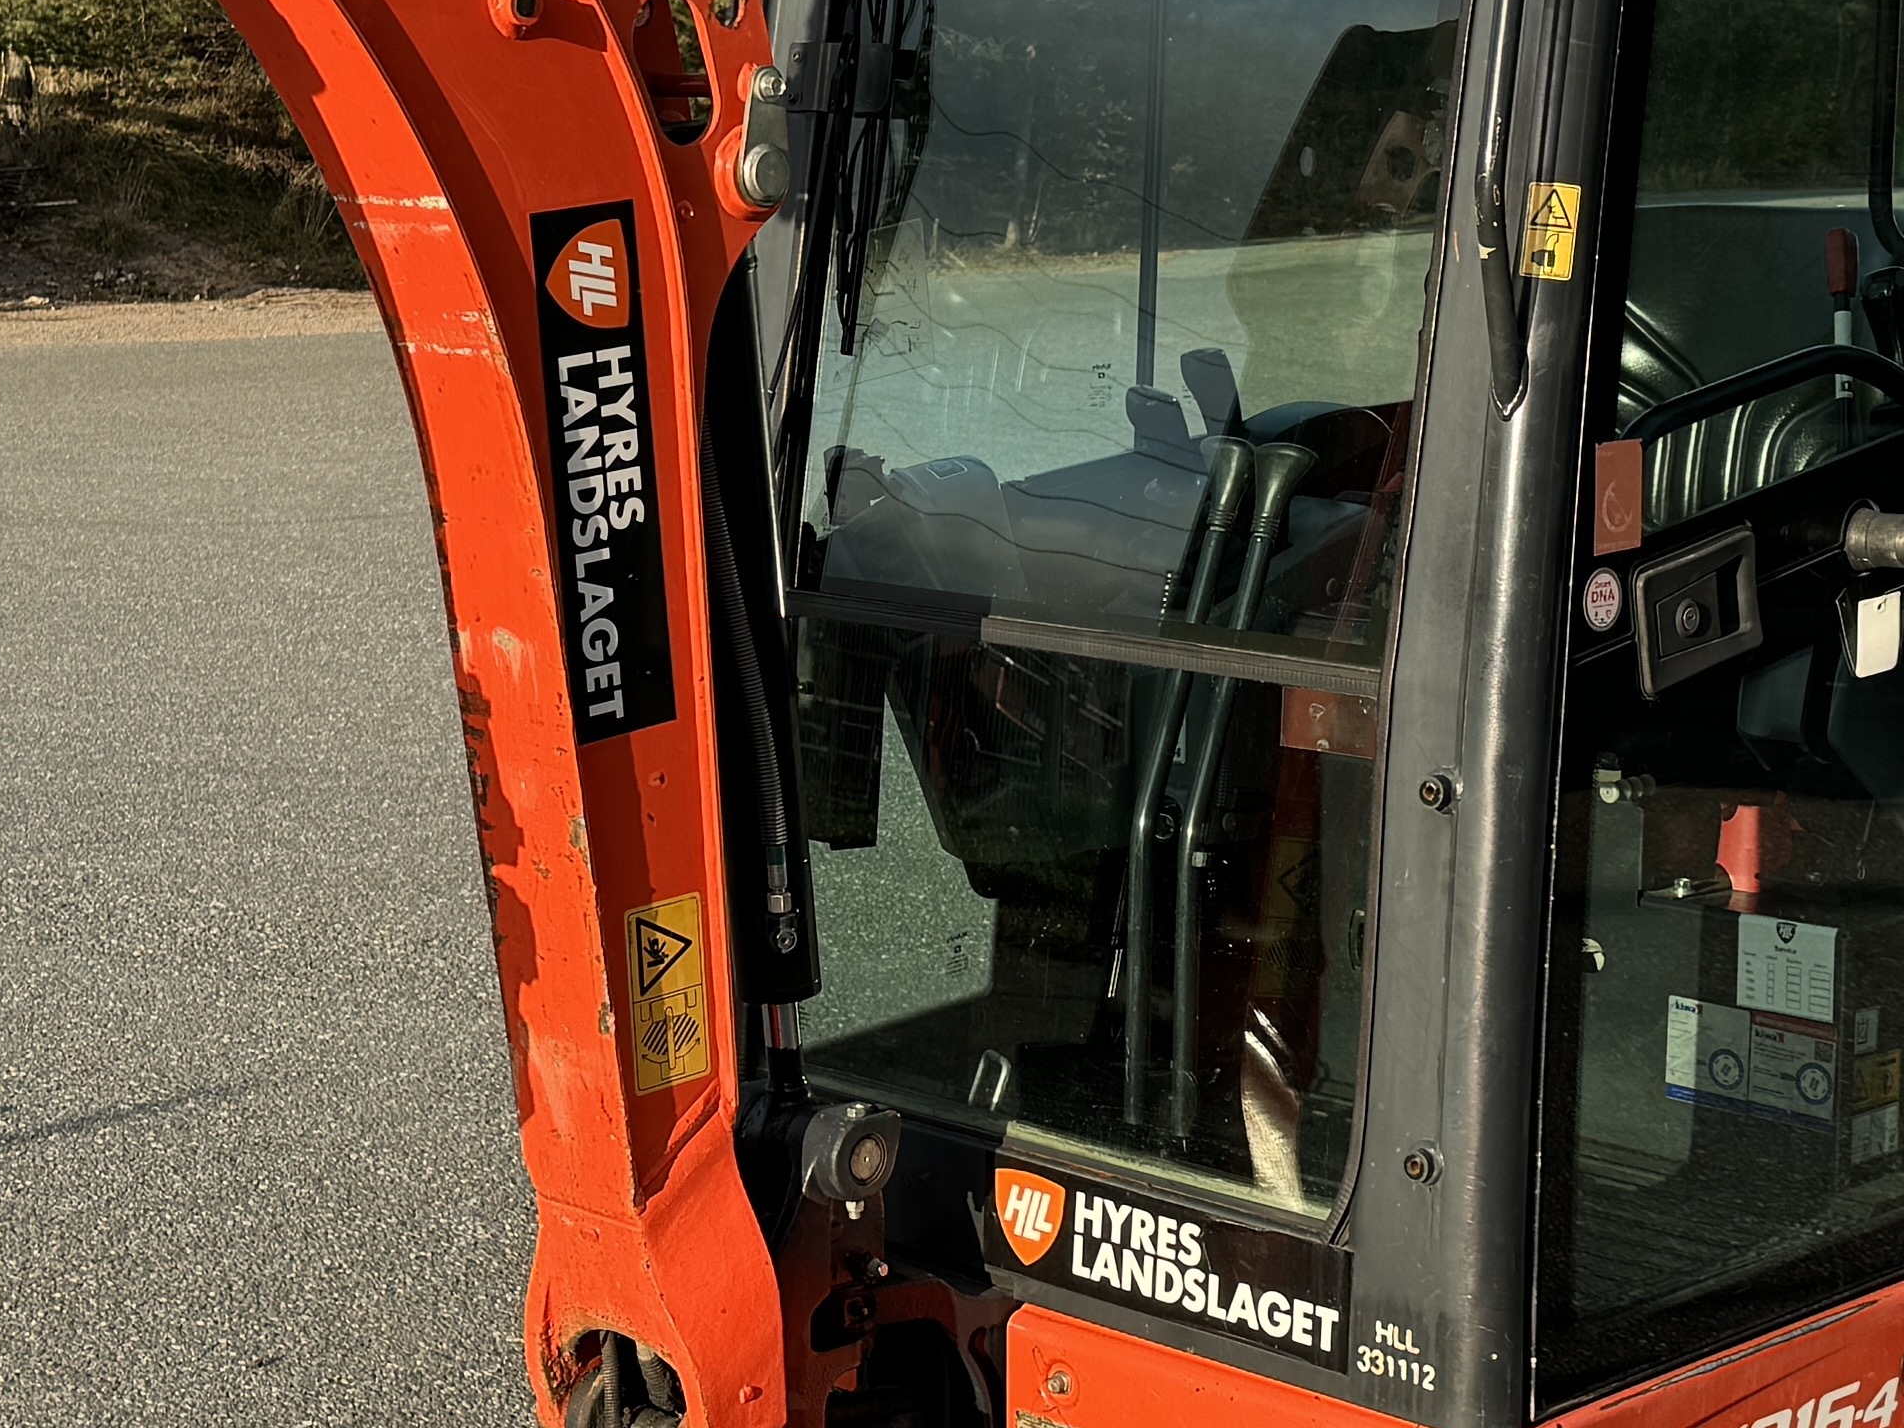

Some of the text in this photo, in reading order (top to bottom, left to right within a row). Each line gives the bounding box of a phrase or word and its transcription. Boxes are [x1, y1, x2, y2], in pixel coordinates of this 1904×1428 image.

[596, 345, 645, 531] HYRES
[557, 351, 626, 720] LANDSLAGET
[1591, 588, 1615, 604] DNA
[1004, 1184, 1053, 1241] HLL
[1074, 1191, 1203, 1267] HYRES
[1072, 1234, 1340, 1352] LANDSLAGET
[1357, 1345, 1436, 1391] 331112
[1375, 1320, 1420, 1354] HLL
